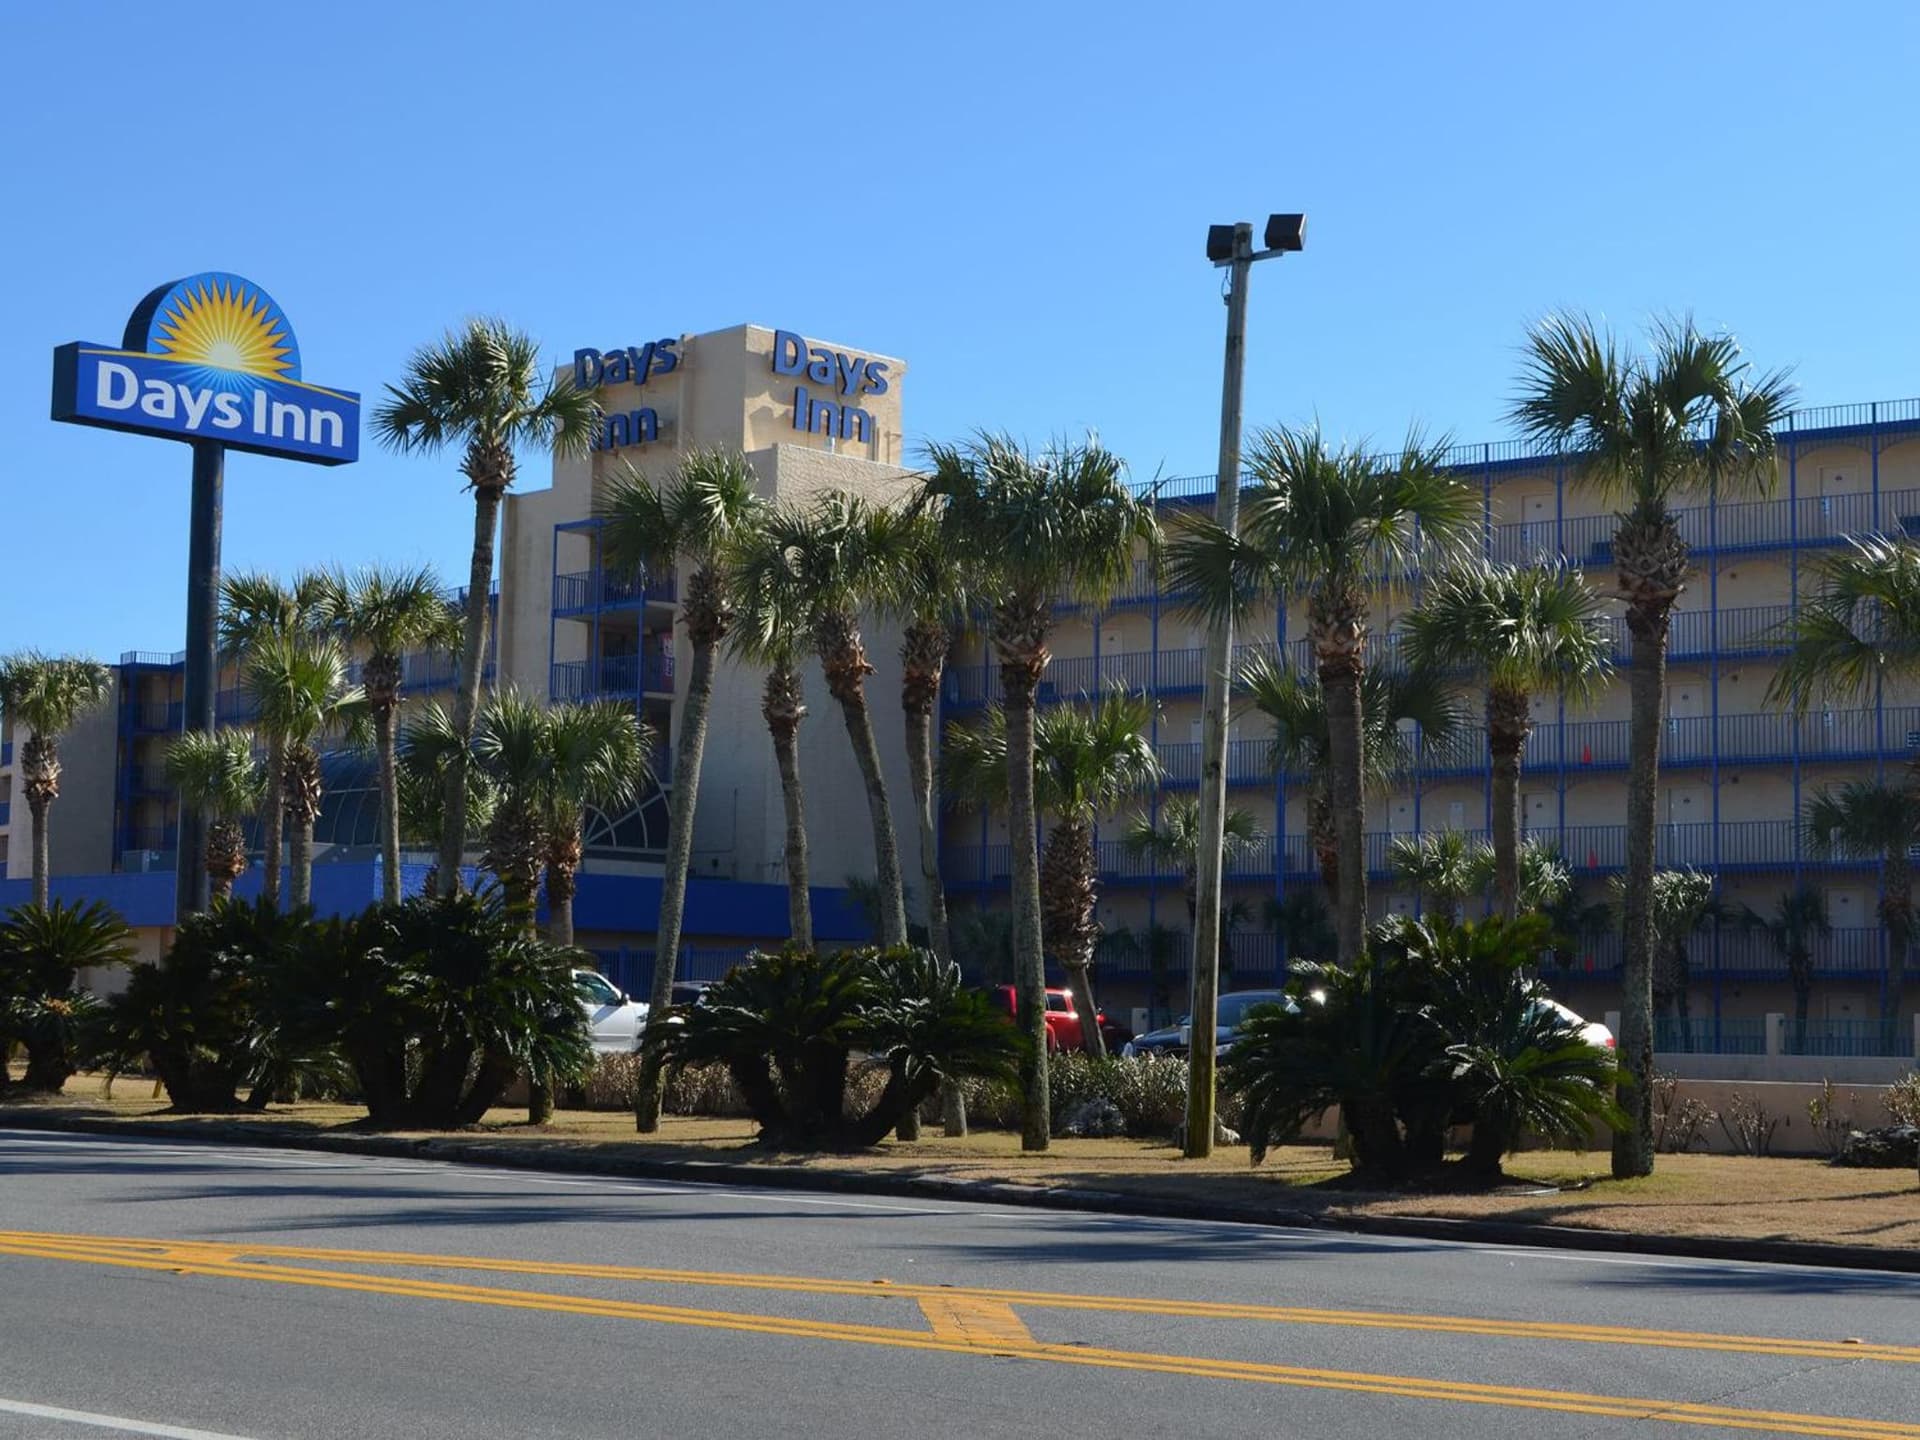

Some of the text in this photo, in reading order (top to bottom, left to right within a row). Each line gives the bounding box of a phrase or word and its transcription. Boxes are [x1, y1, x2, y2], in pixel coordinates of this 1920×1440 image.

[574, 338, 677, 390] Days
[774, 329, 888, 395] Days
[97, 361, 343, 448] Days Inn
[793, 386, 871, 443] Inn
